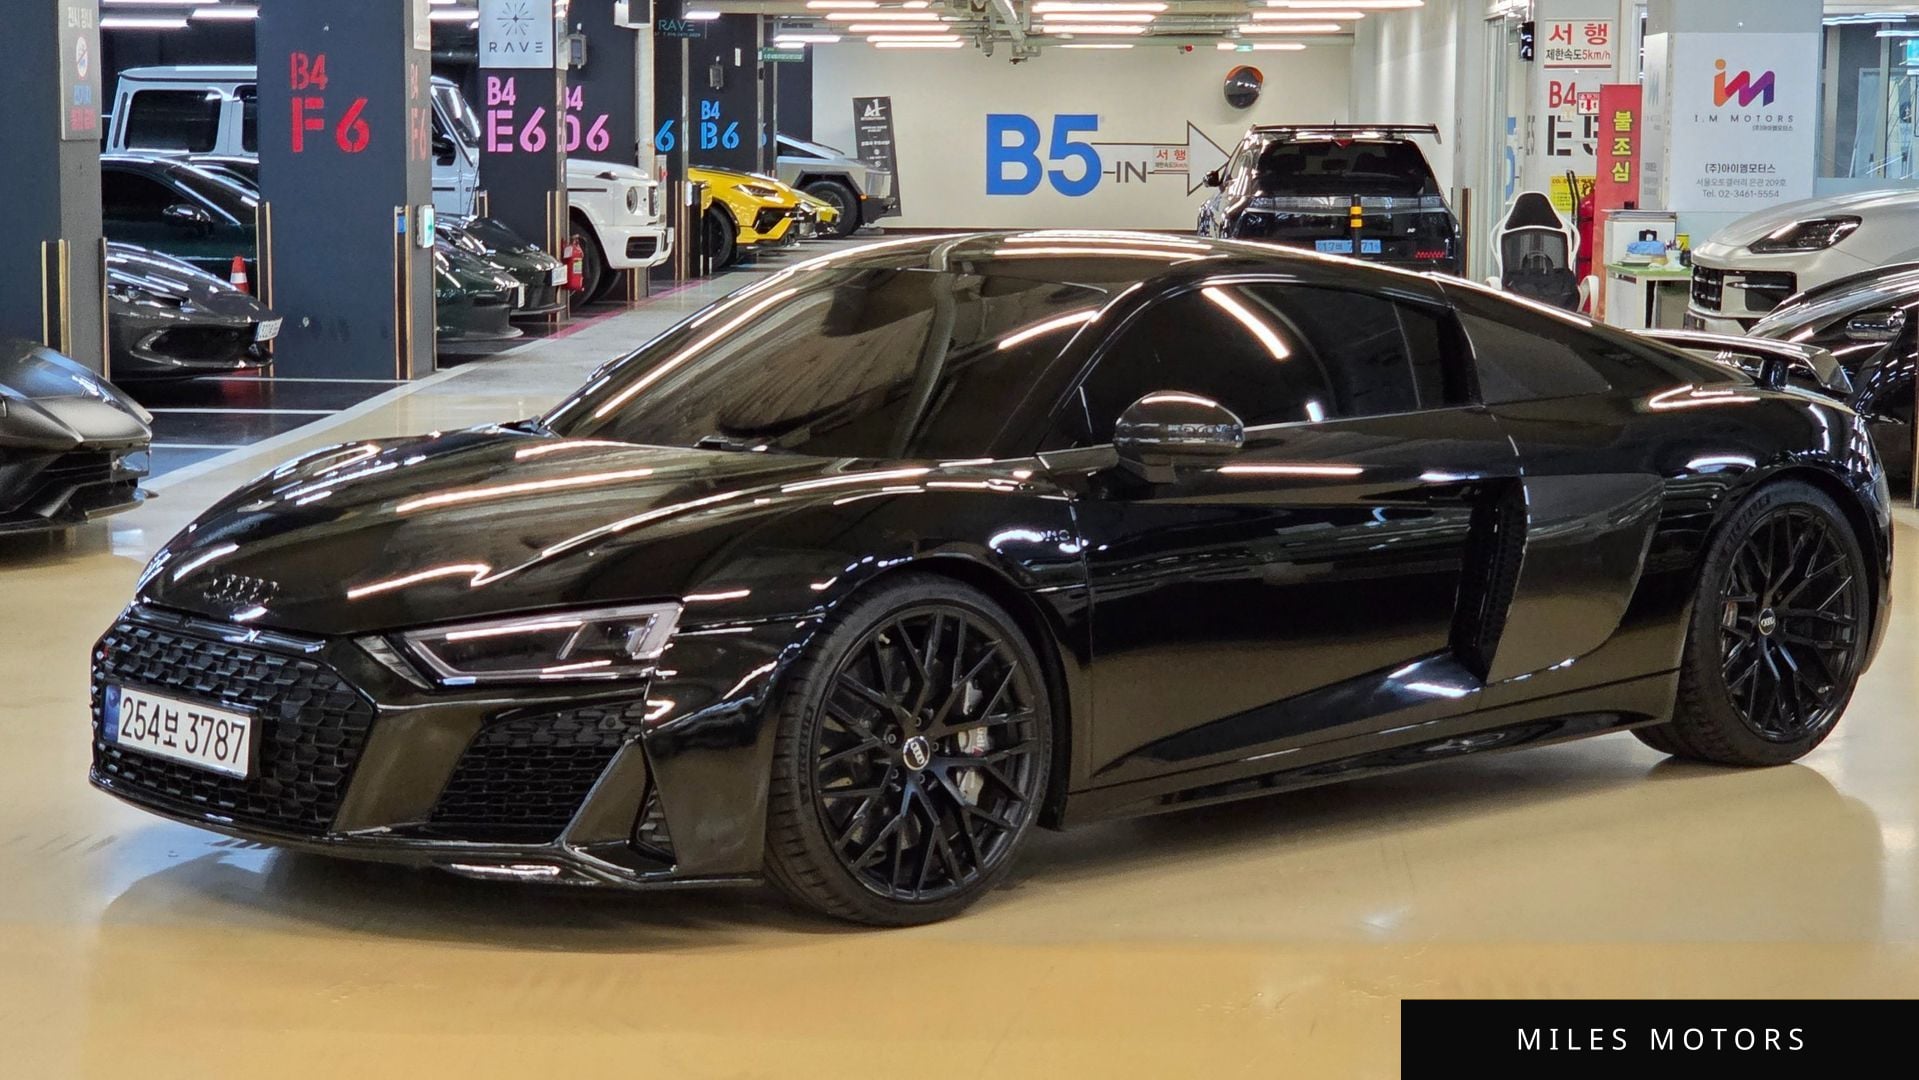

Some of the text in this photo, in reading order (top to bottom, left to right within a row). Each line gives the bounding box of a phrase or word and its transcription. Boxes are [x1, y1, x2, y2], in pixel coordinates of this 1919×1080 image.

[659, 19, 694, 31] RAVE
[489, 42, 543, 53] RAVE
[1546, 49, 1611, 61] 제한속도5km/h
[290, 52, 328, 90] B4
[487, 76, 516, 106] B4
[1548, 80, 1577, 108] B4
[701, 100, 721, 120] B4
[1730, 114, 1794, 123] MOTORS
[487, 106, 546, 153] E6
[701, 121, 740, 149] B6
[986, 113, 1102, 197] B5
[1116, 160, 1147, 184] IN
[1705, 163, 1776, 174] (주)아이엠모터스
[1703, 189, 1780, 198] Tel. 02-3461-5554
[121, 697, 245, 764] 254보 3787
